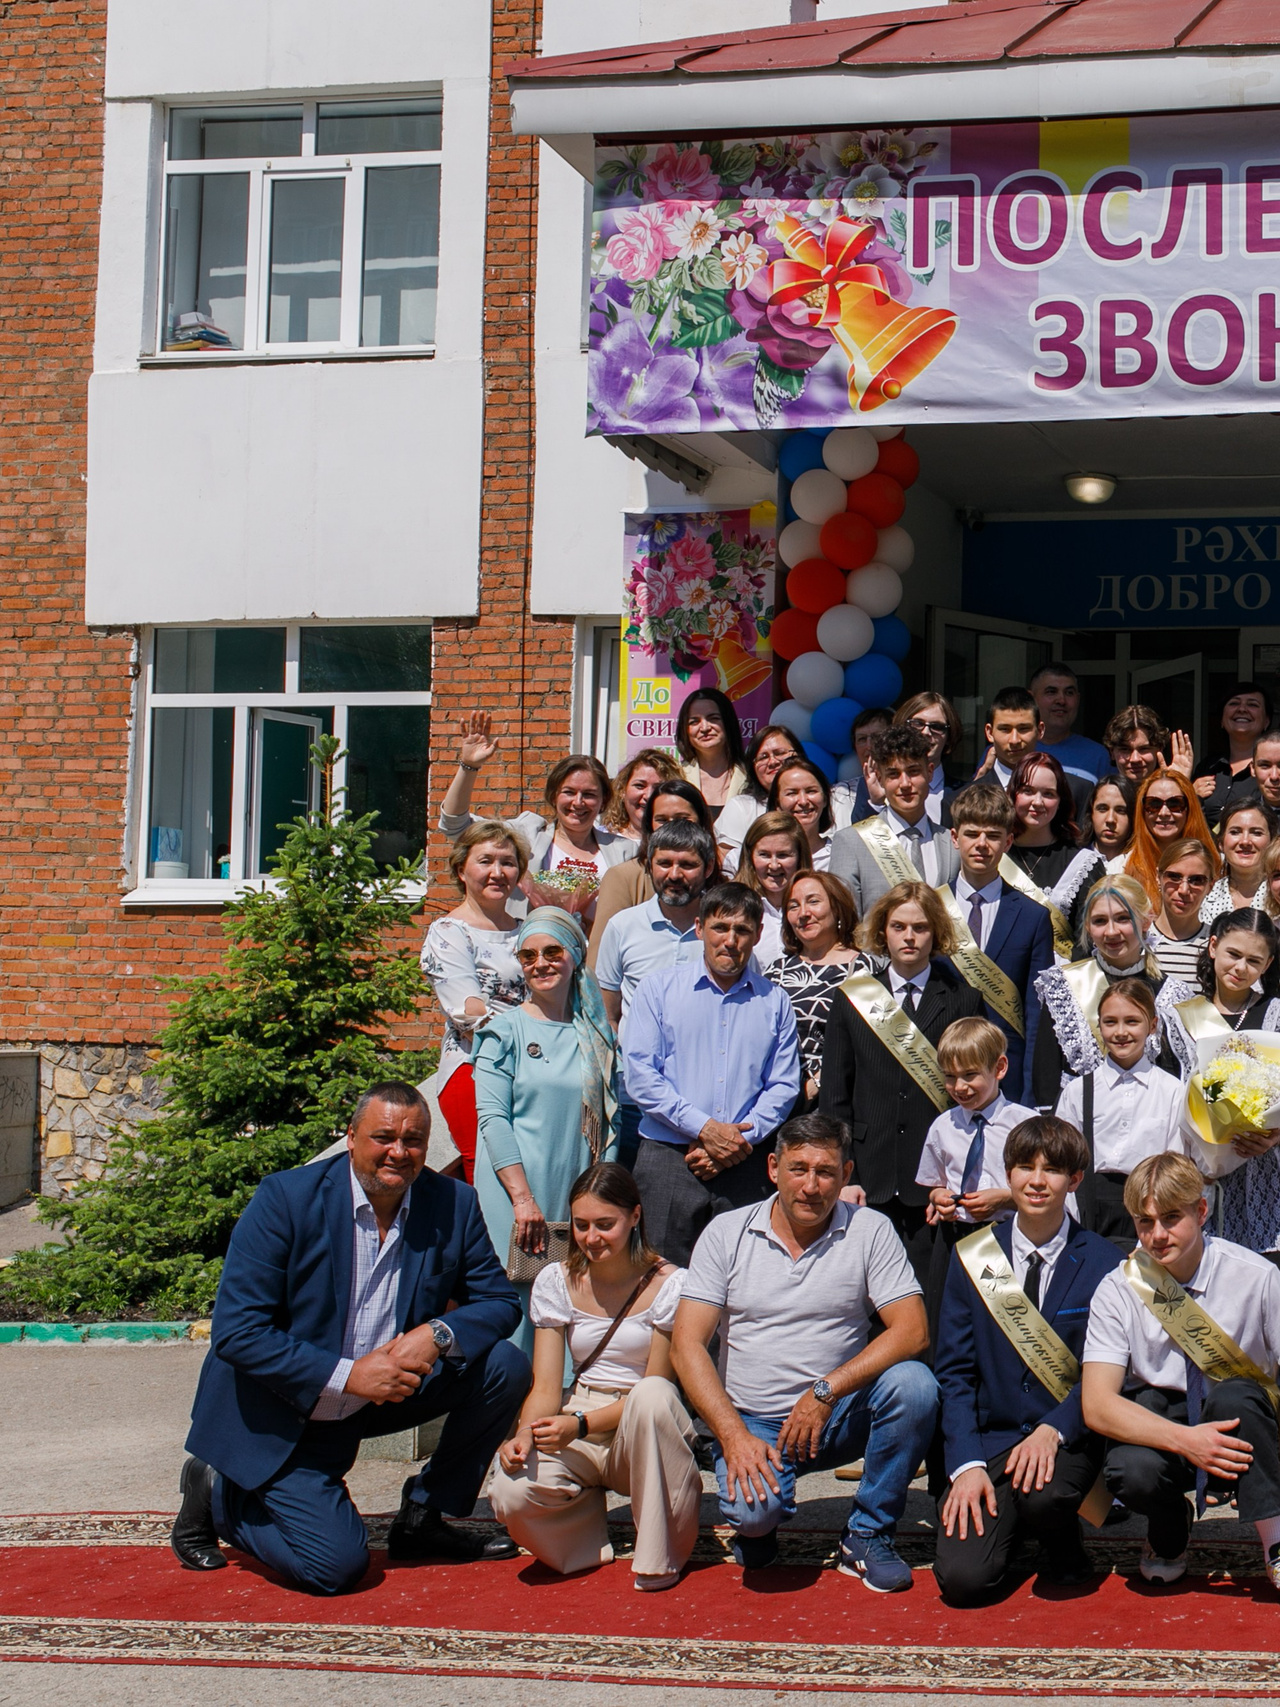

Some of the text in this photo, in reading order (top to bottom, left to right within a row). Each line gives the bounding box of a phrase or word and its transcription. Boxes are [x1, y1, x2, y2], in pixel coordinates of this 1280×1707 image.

[1089, 571, 1271, 621] ДОБРО
[632, 681, 670, 710] До
[891, 1024, 948, 1095] Выпускник
[1001, 1293, 1067, 1381] Выпускник
